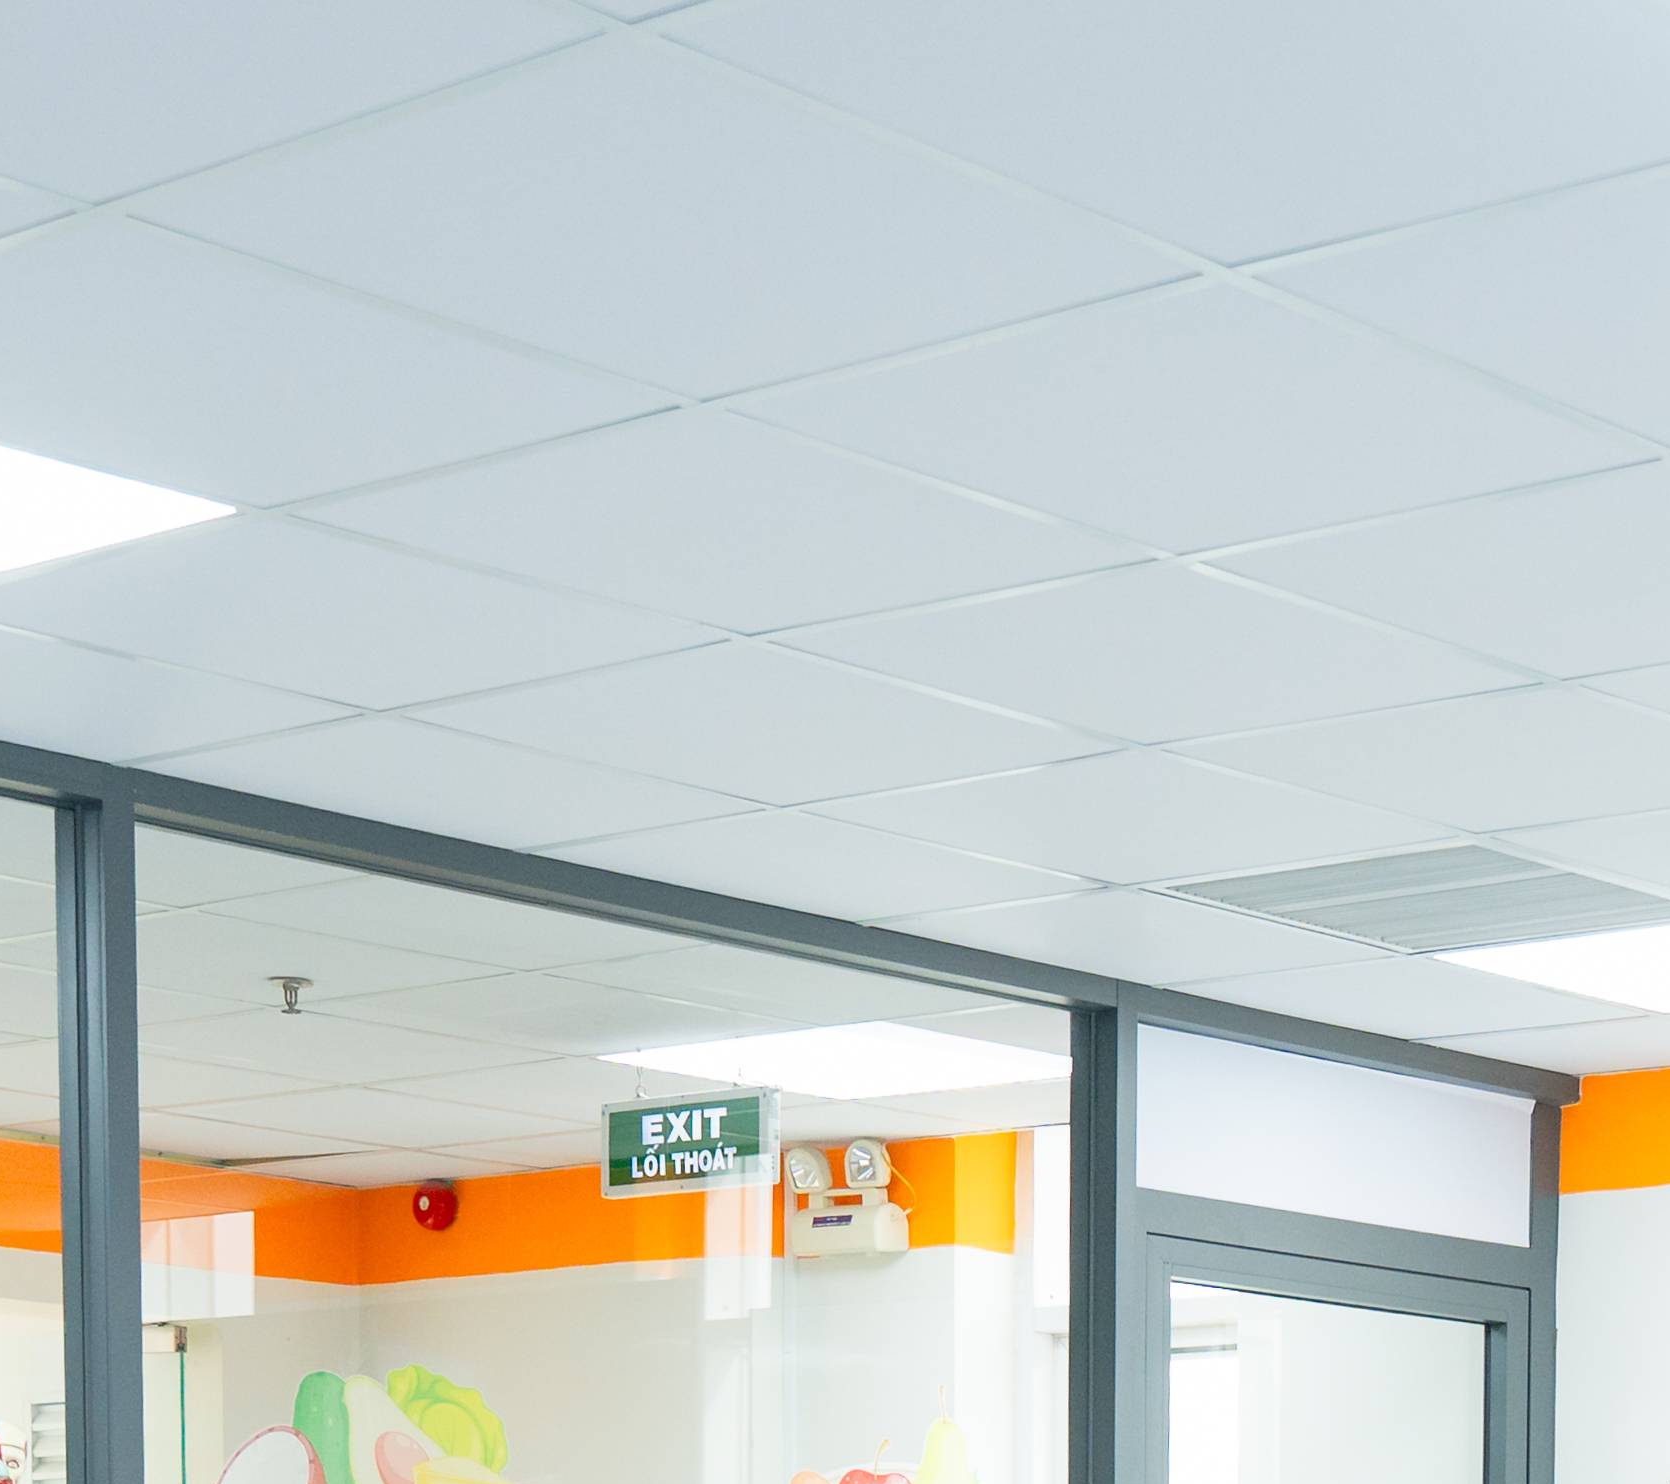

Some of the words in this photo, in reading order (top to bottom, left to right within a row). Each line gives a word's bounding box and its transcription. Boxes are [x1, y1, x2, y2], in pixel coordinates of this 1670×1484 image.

[641, 1106, 728, 1146] EXIT
[631, 1144, 667, 1179] LỐI
[671, 1142, 737, 1175] THOÁT
